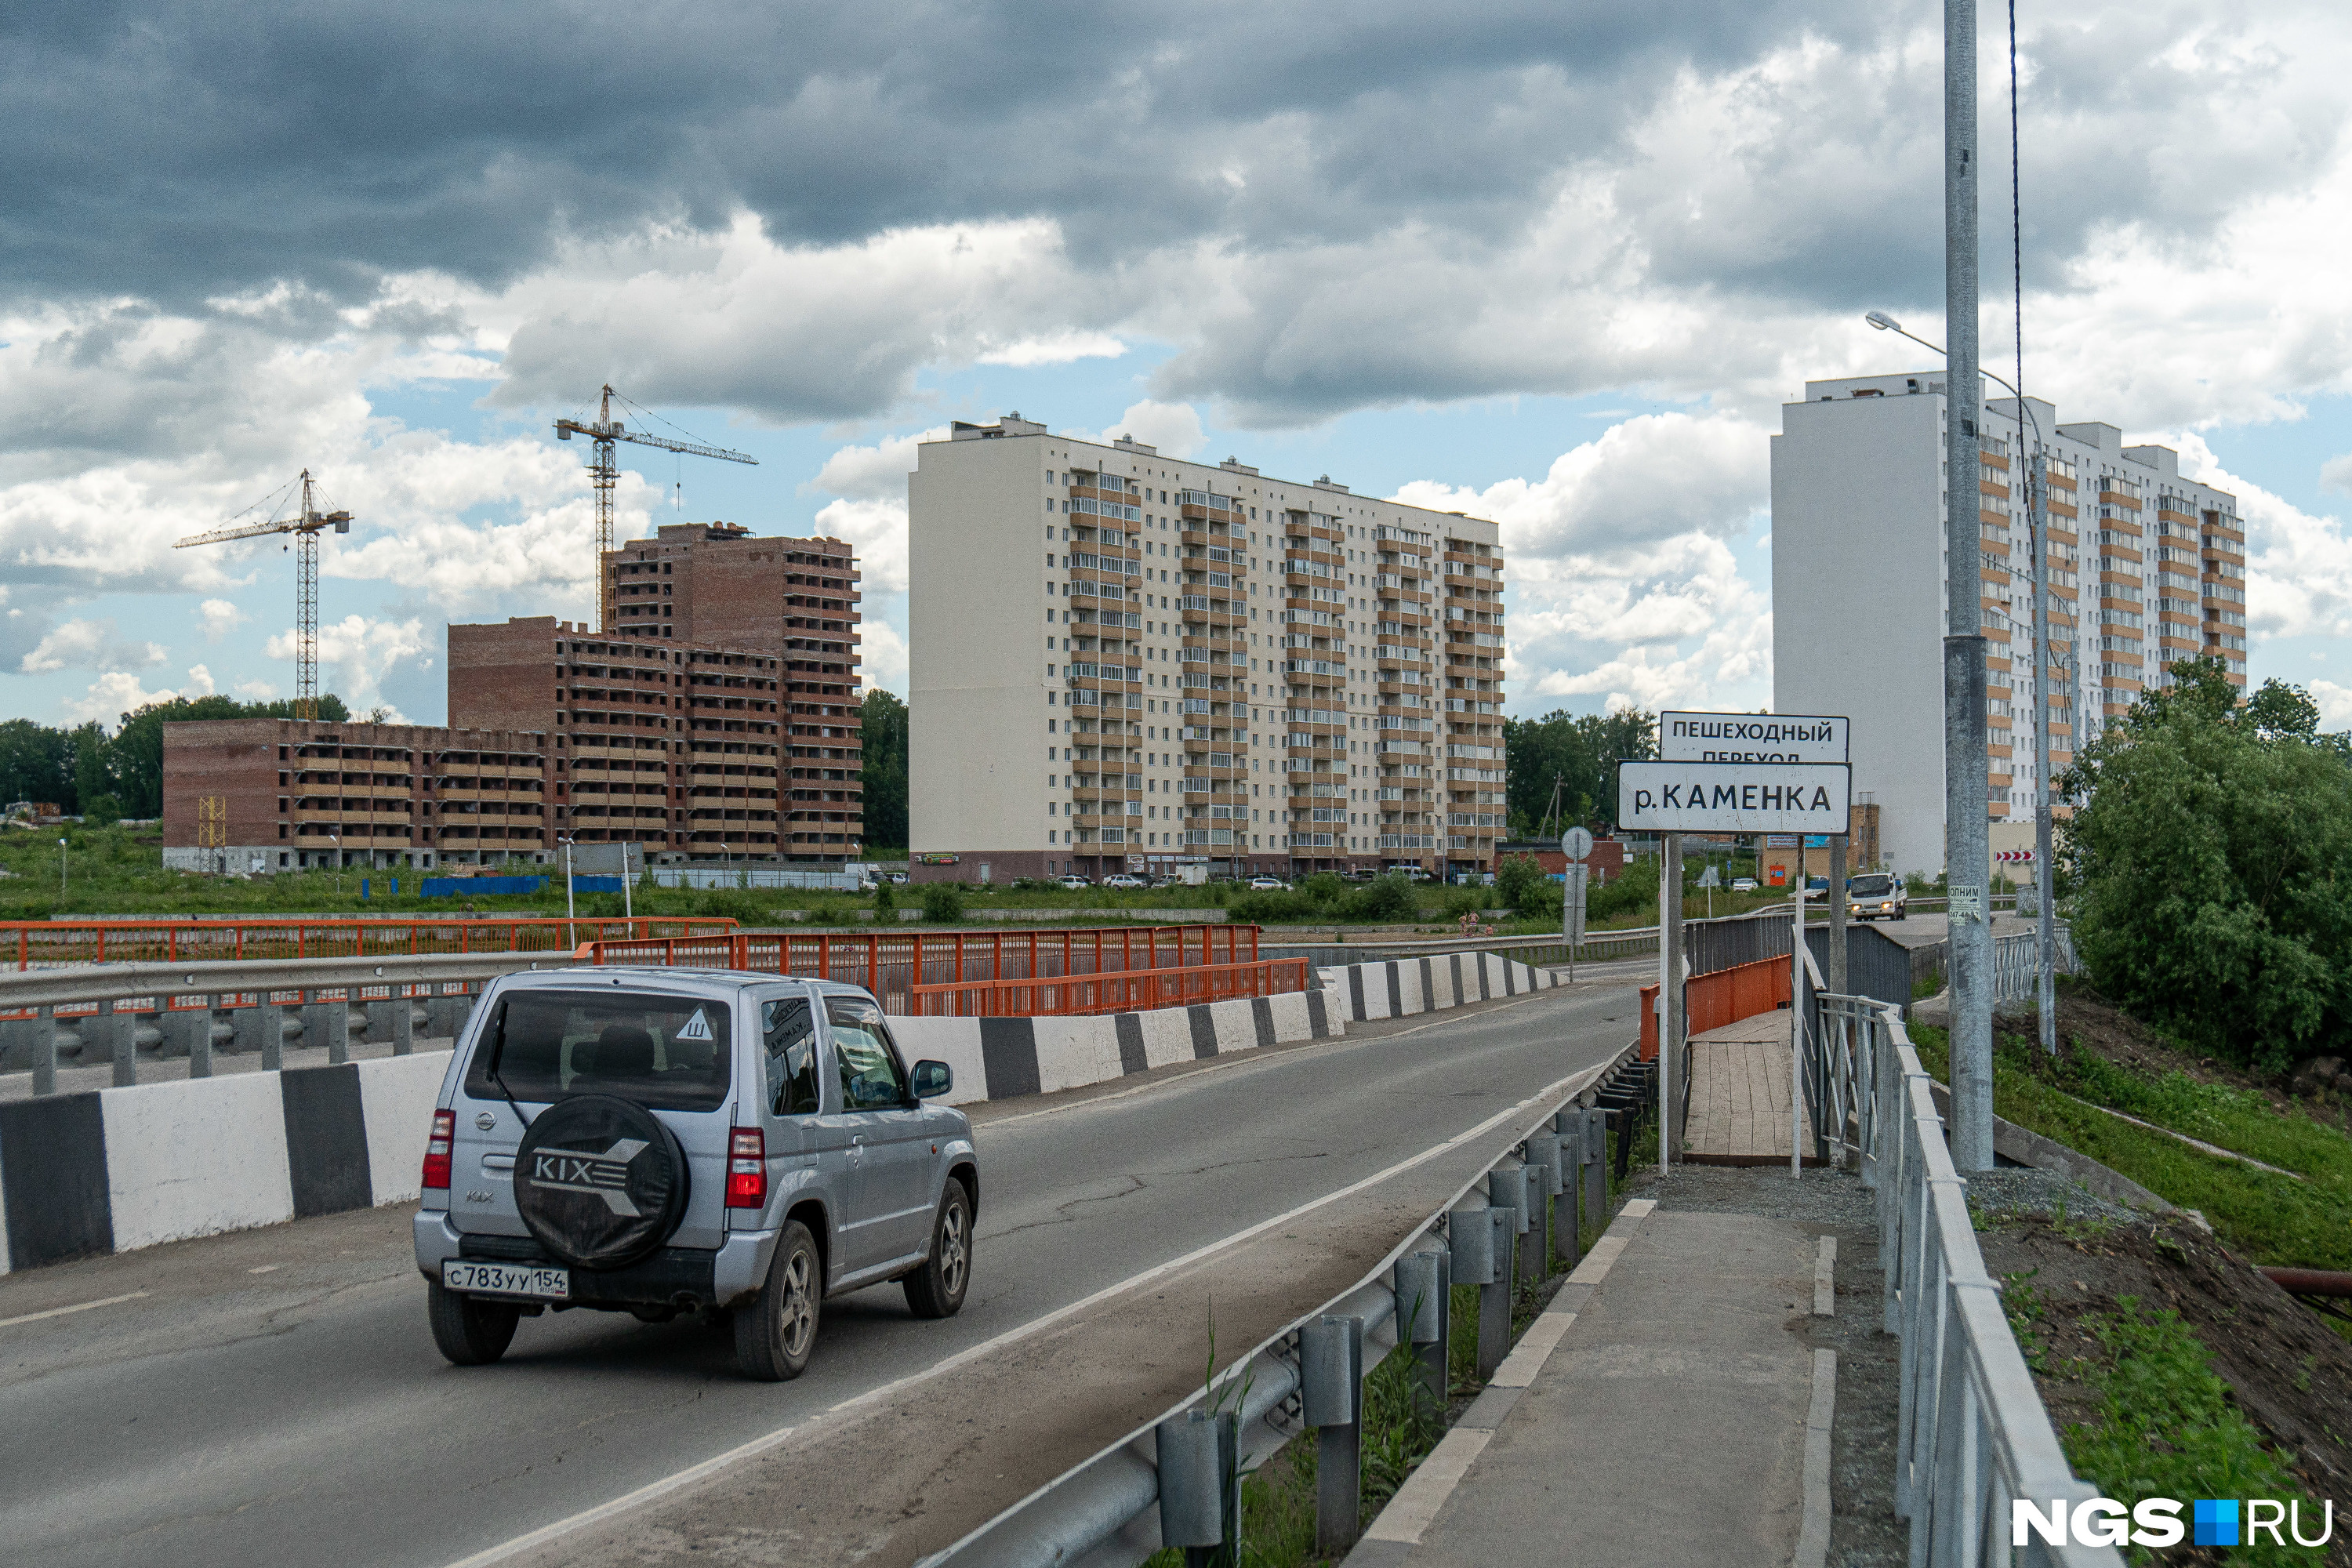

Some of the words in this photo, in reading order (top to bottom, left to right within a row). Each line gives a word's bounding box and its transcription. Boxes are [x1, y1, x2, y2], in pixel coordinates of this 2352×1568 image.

[1673, 720, 1832, 744] ПЕШЕХОДНЫЙ
[1635, 784, 1831, 815] р.КАМЕНКА
[1949, 887, 1979, 897] ОЛНИМ
[687, 1022, 705, 1038] Ш
[535, 1156, 593, 1184] KIX
[466, 1189, 494, 1203] KIX
[533, 1271, 564, 1289] 154
